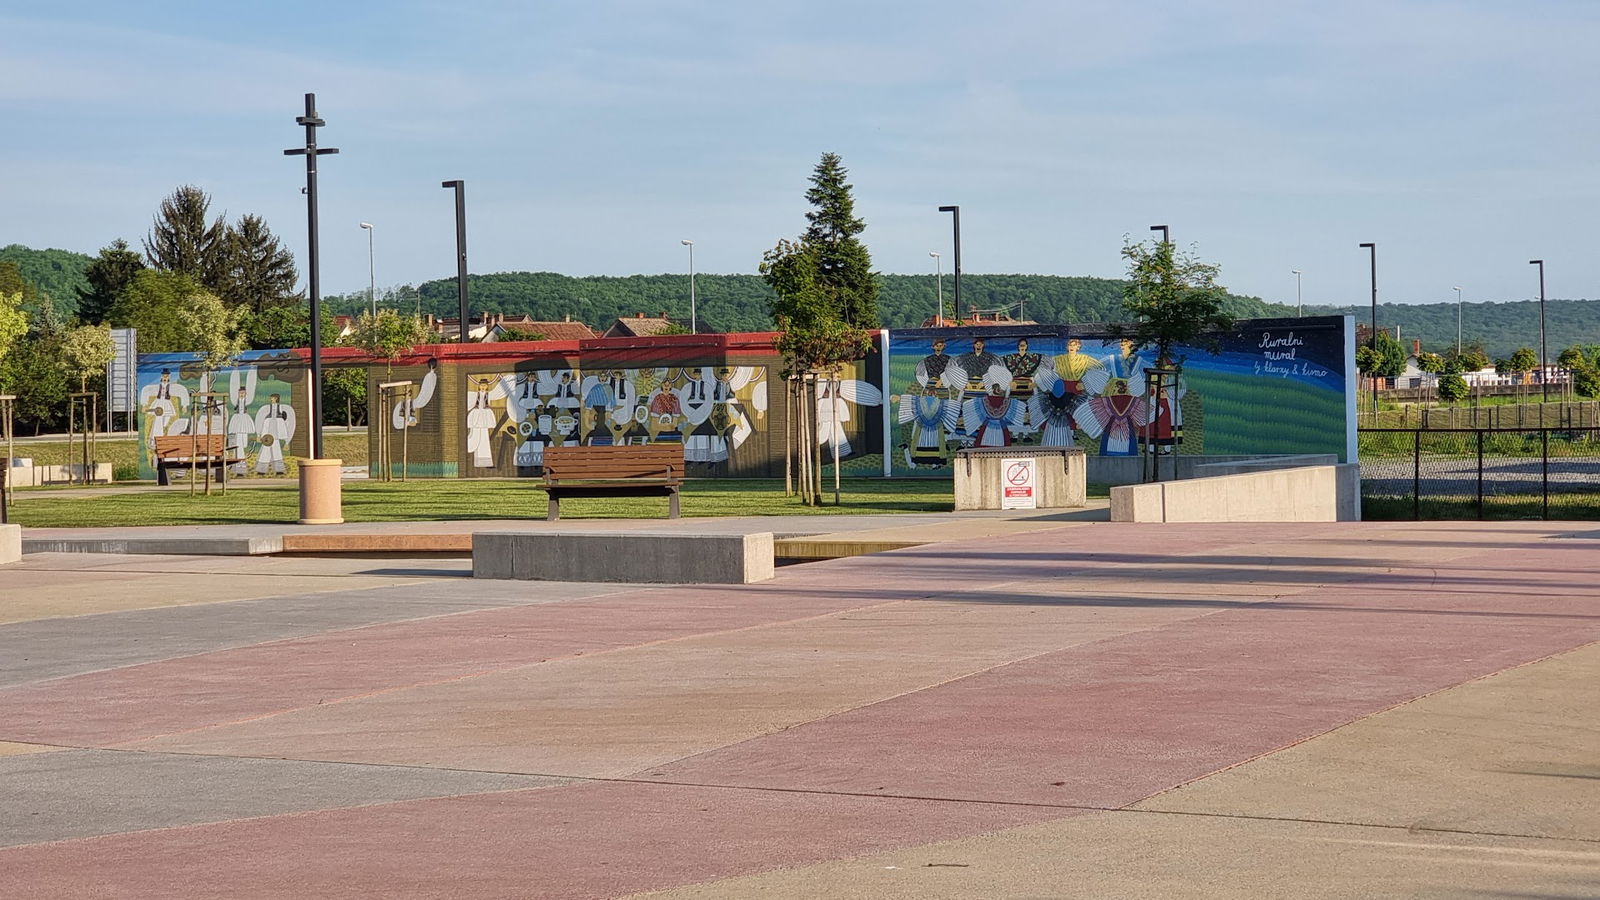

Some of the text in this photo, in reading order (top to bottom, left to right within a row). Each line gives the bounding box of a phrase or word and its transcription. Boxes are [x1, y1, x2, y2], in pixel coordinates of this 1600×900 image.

[1258, 331, 1304, 349] Ruralni
[1264, 348, 1296, 361] mural
[1254, 360, 1261, 375] by
[1291, 363, 1298, 375] &
